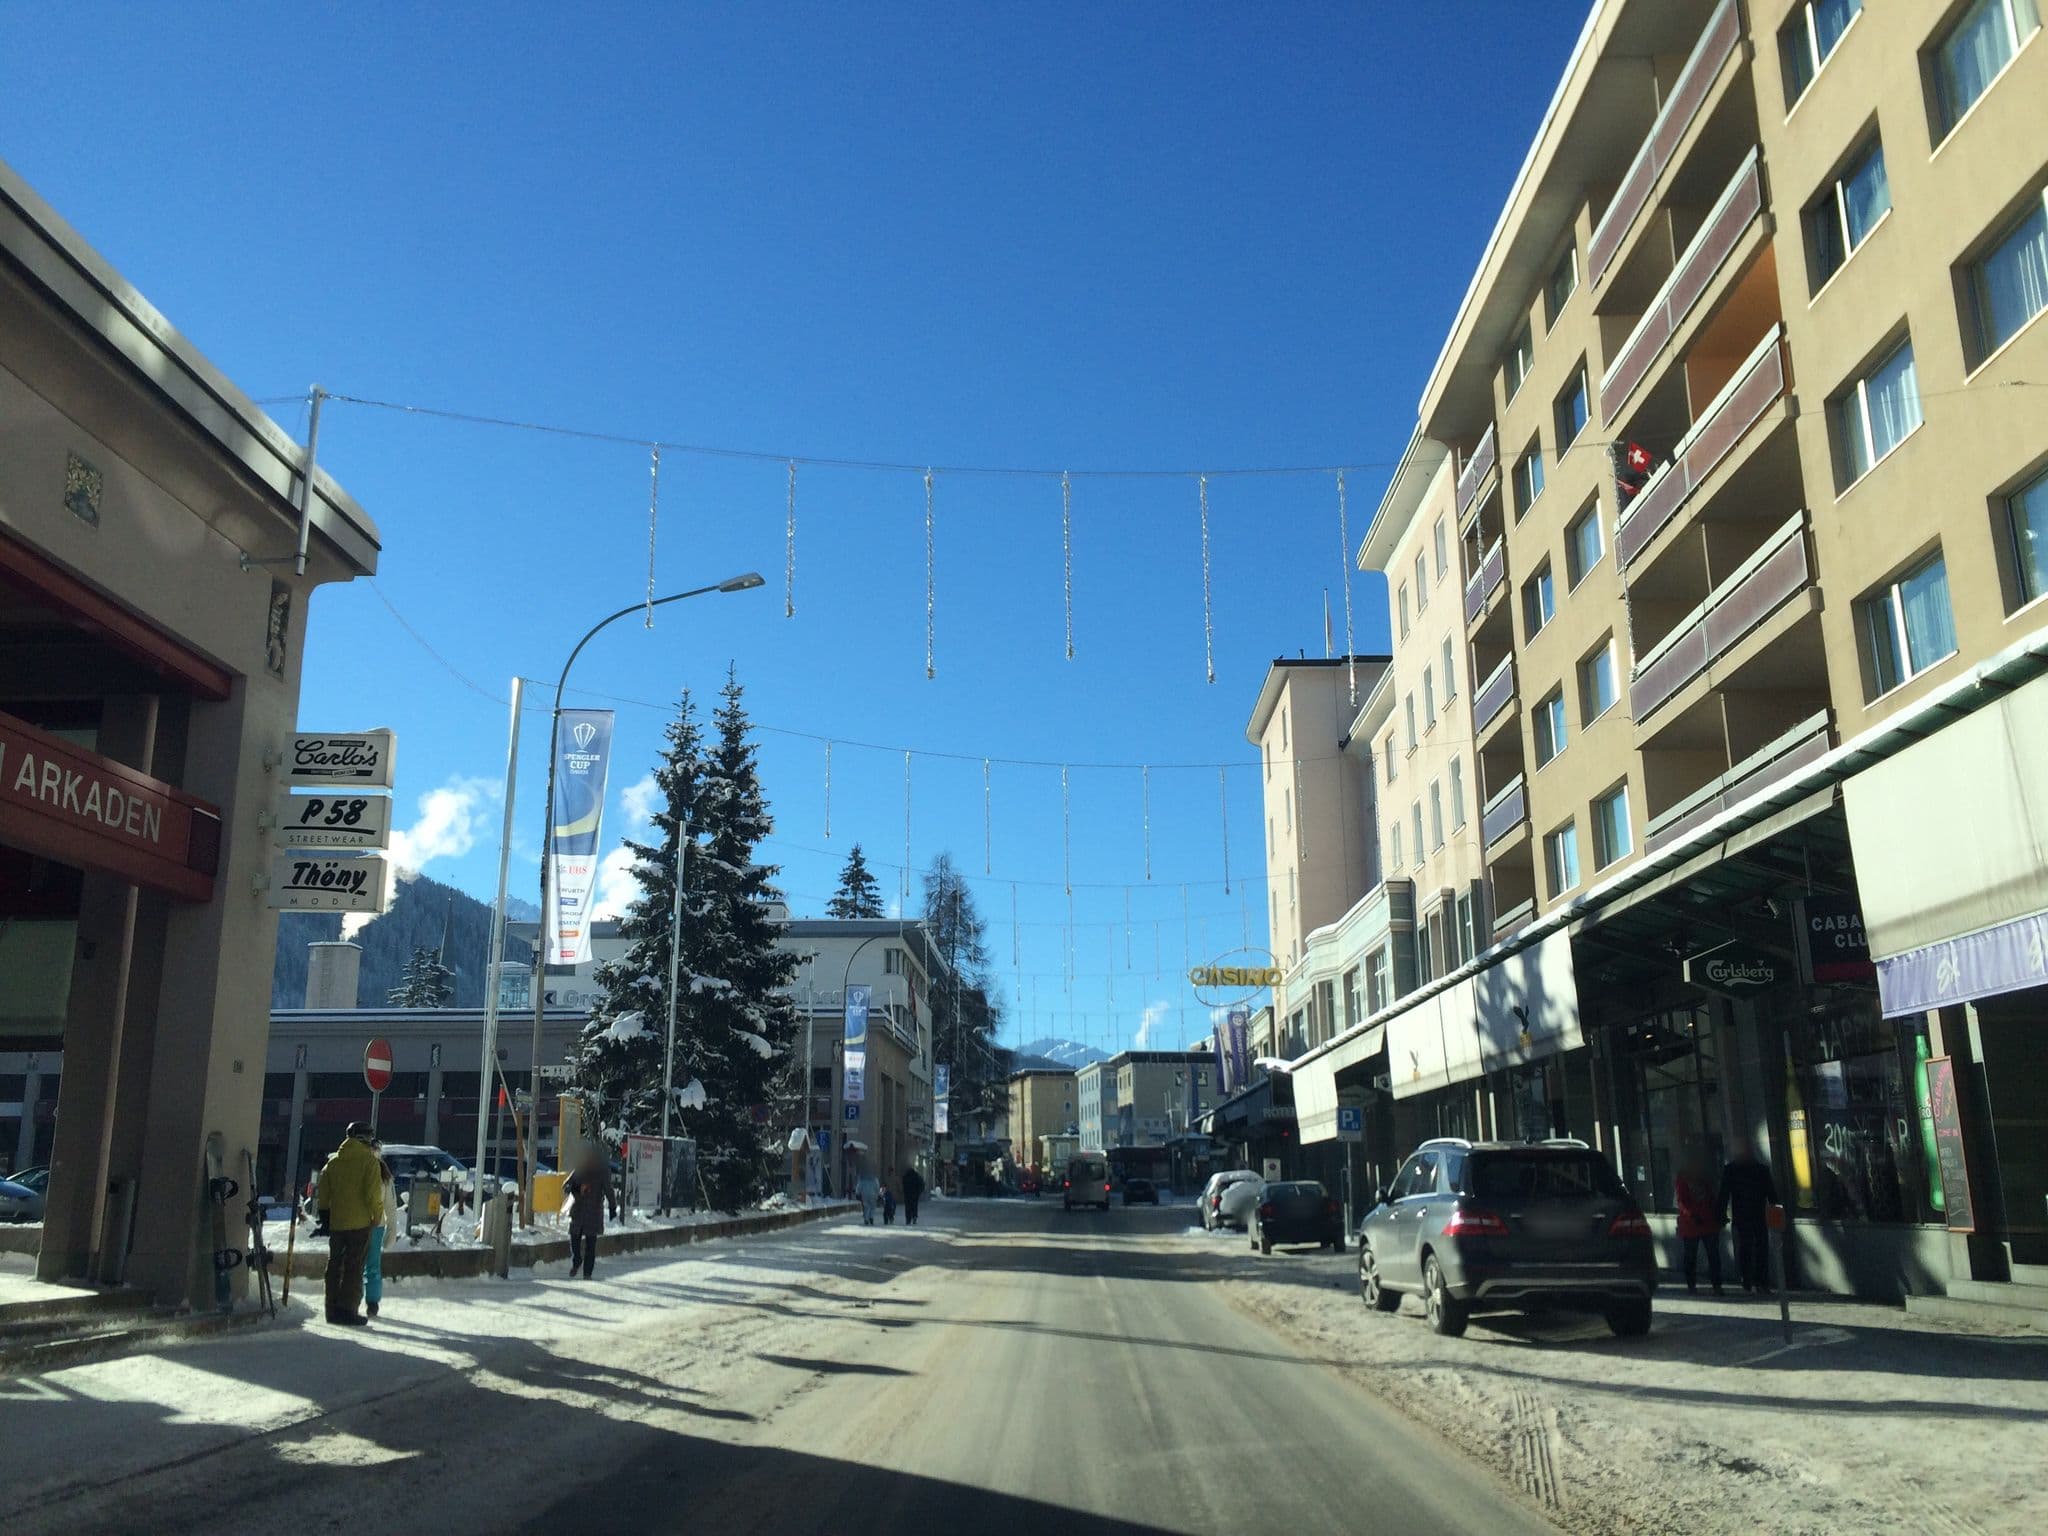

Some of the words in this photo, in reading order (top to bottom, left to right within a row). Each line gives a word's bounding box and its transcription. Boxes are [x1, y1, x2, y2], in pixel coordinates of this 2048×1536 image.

[294, 739, 379, 767] Carlo's
[569, 760, 591, 770] CUP
[14, 752, 162, 844] ARKADEN
[300, 798, 325, 824] P
[324, 798, 368, 826] 58
[289, 834, 365, 844] STREETWEAR
[291, 862, 368, 894] Thöny
[289, 898, 359, 906] MODE
[1811, 914, 1862, 932] CABA
[1834, 933, 1868, 949] CLU
[1190, 966, 1283, 987] CASINO
[1705, 959, 1774, 982] Carlsberg
[848, 1107, 857, 1119] P
[1342, 1110, 1354, 1127] P
